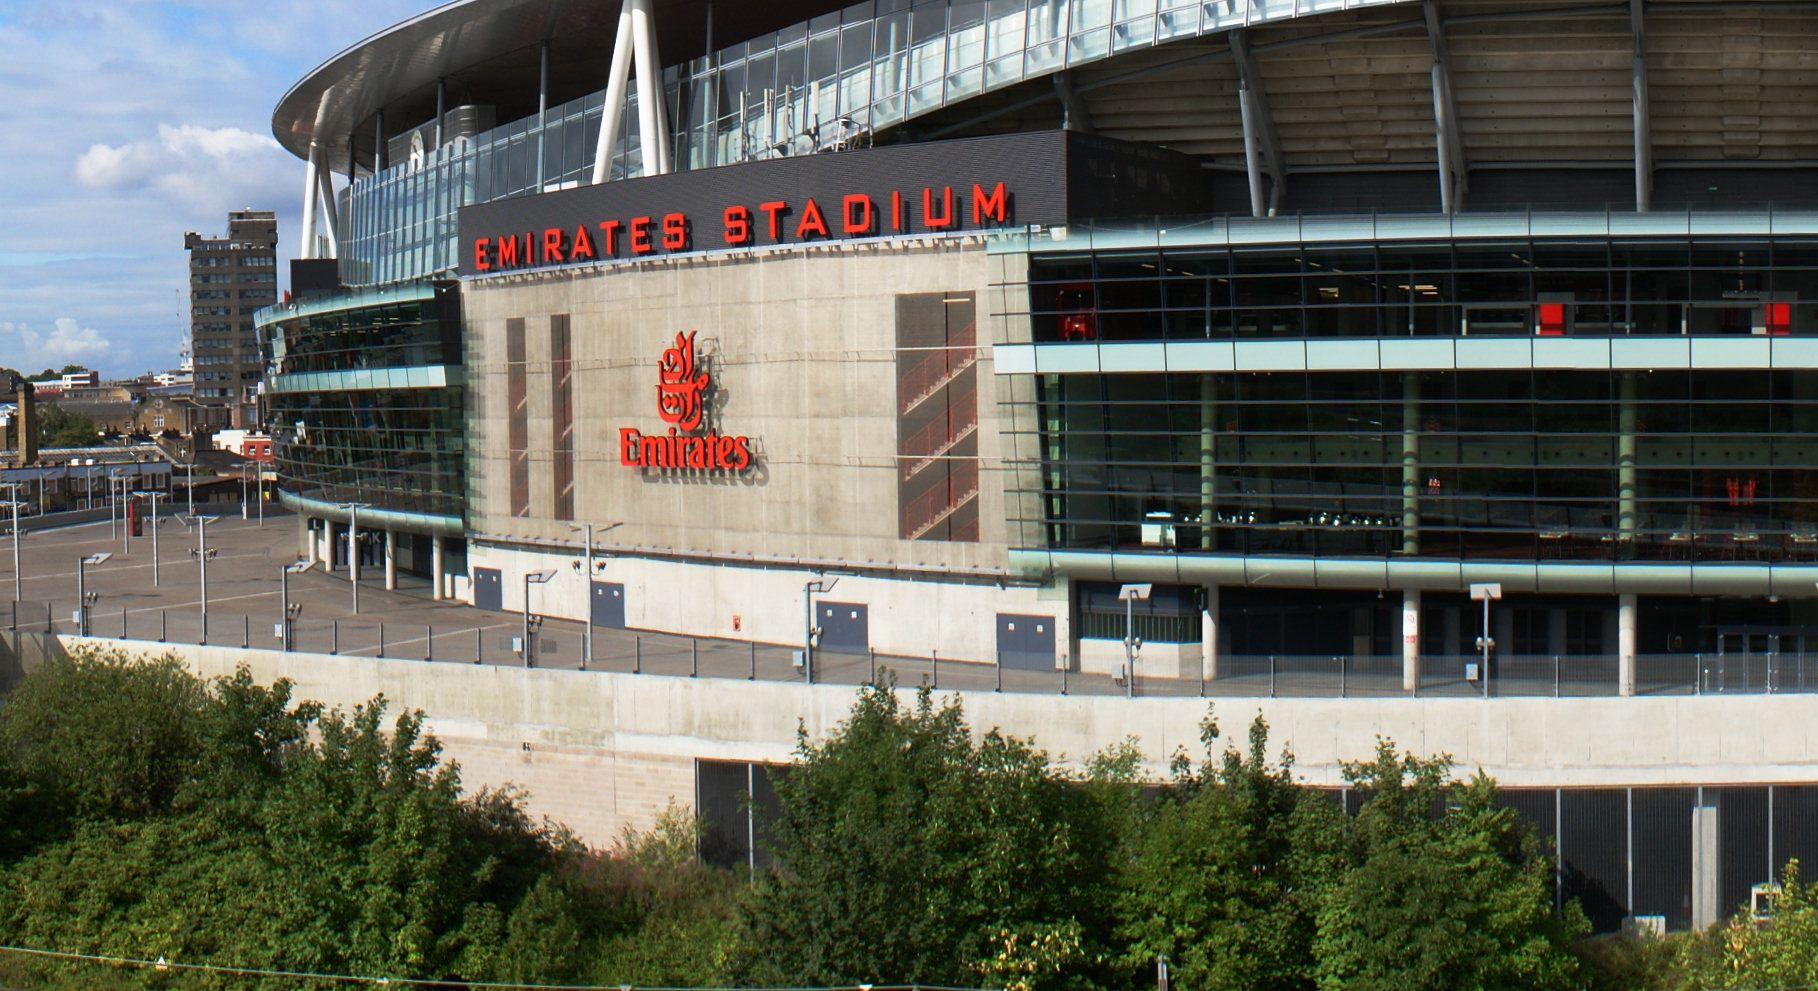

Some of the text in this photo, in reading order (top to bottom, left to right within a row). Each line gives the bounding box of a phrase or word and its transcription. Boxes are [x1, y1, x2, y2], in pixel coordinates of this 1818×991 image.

[476, 182, 1006, 270] EMIRATES STADIUM
[619, 427, 750, 470] Emirates
